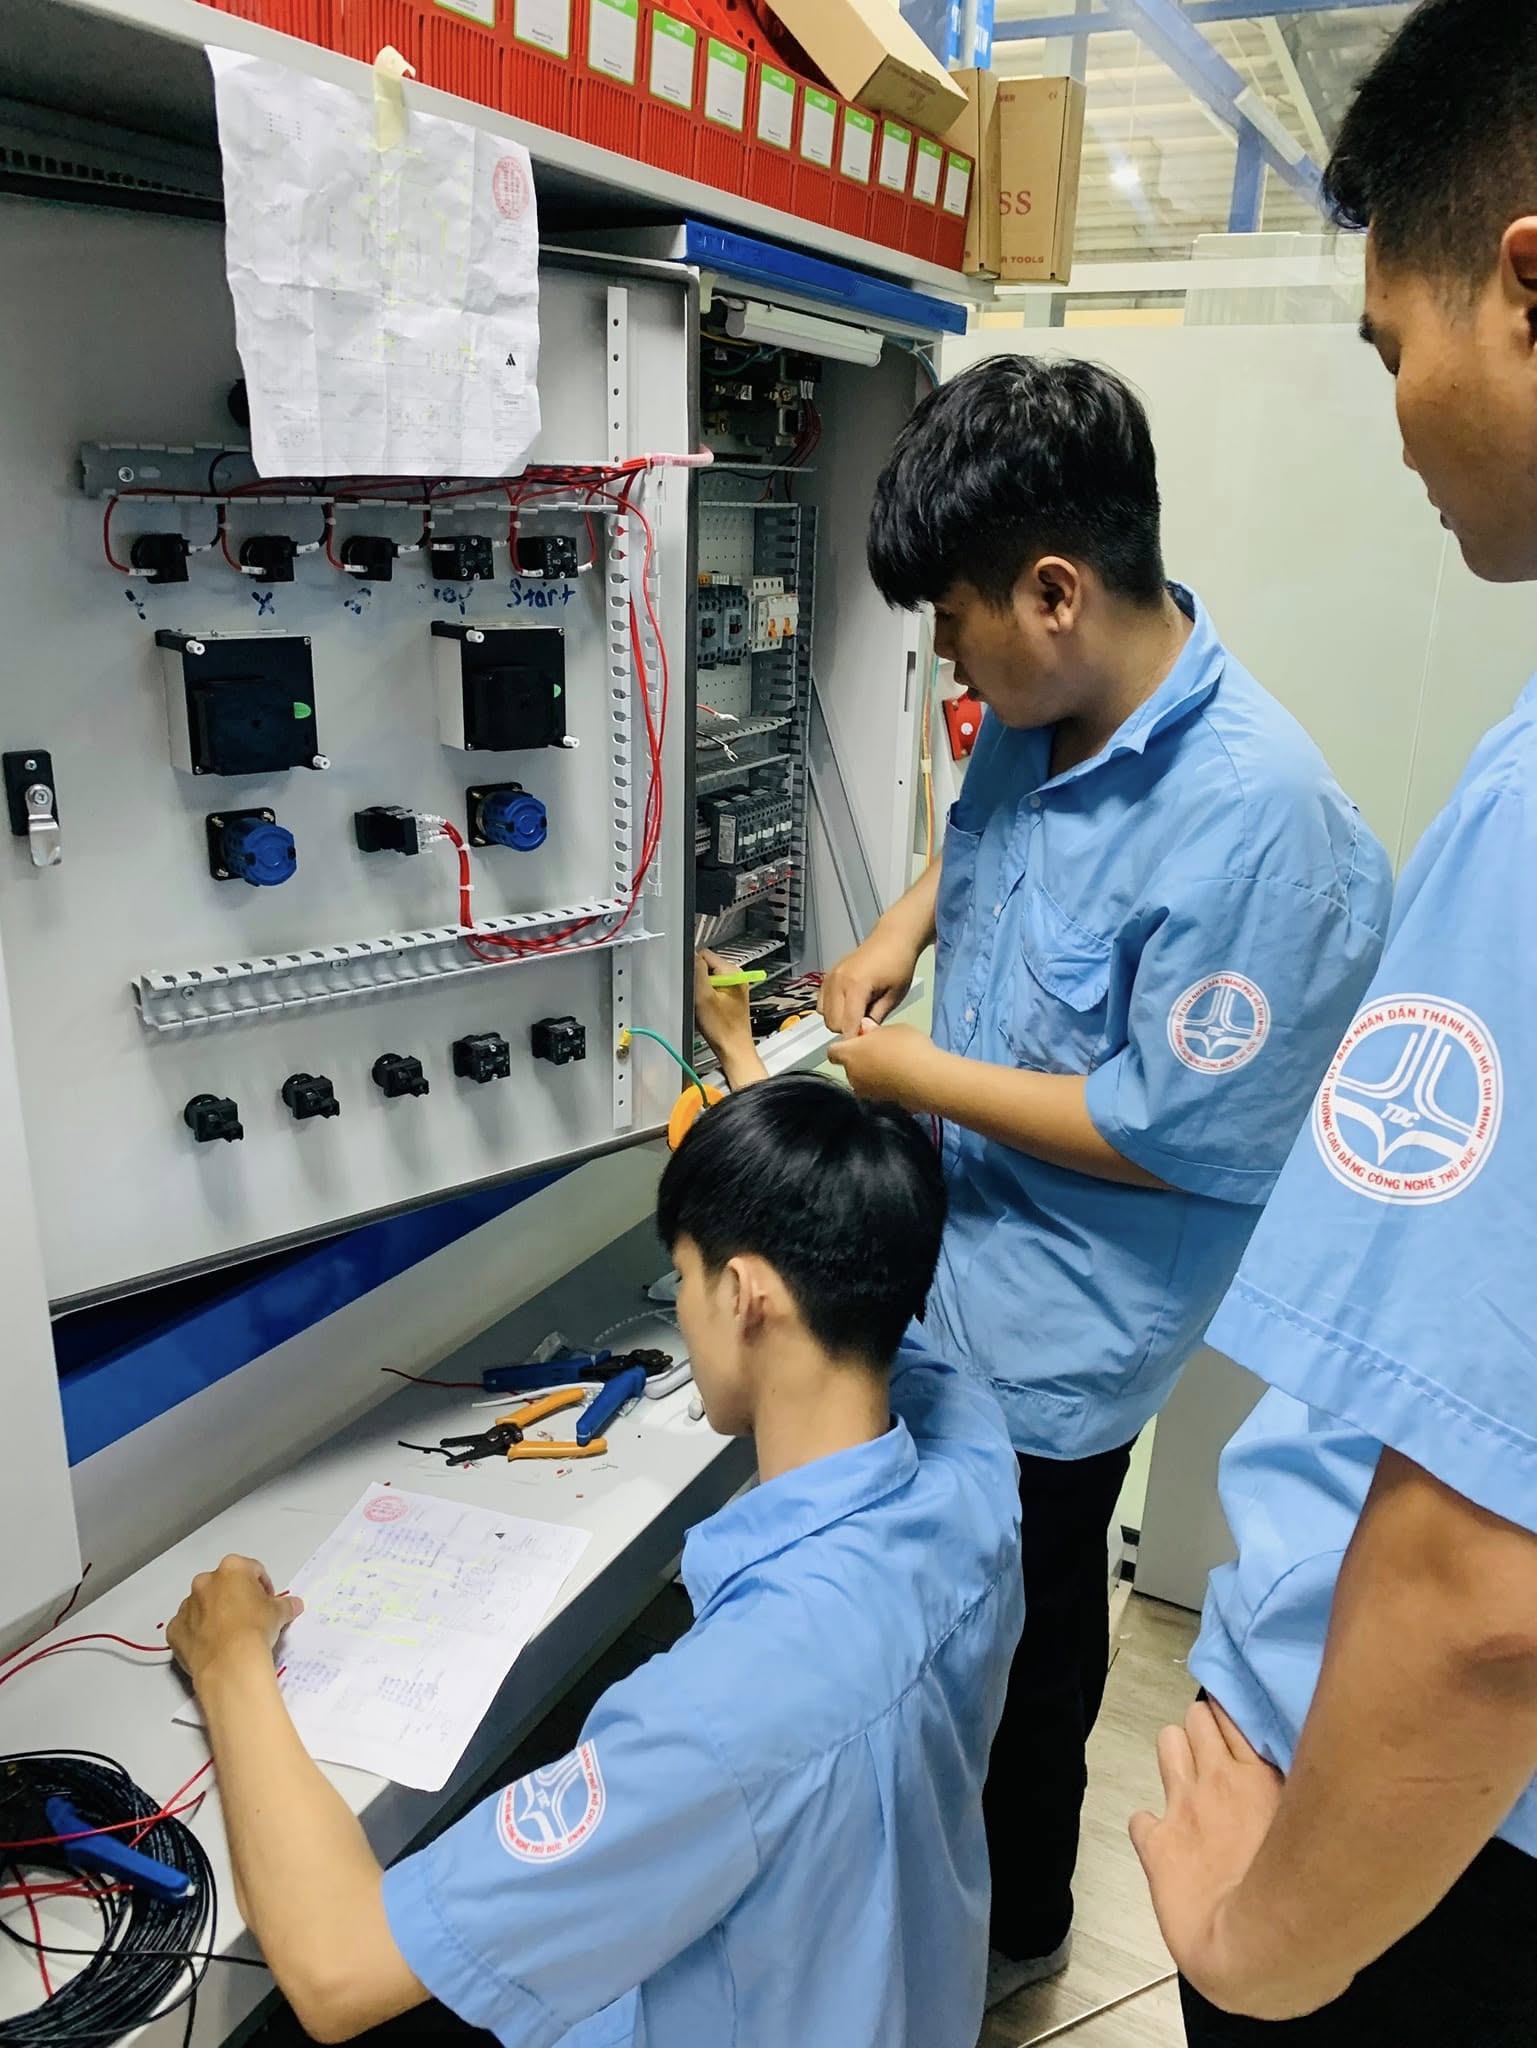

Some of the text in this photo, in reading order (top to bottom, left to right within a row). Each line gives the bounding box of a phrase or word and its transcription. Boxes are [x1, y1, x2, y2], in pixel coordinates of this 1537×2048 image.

[1011, 256, 1044, 264] TOOLS
[251, 591, 275, 616] X
[506, 577, 576, 608] Start
[1336, 1036, 1353, 1061] BAN
[1476, 1105, 1491, 1139] MINH
[1380, 1102, 1420, 1128] TDC
[1327, 1132, 1341, 1153] CAO
